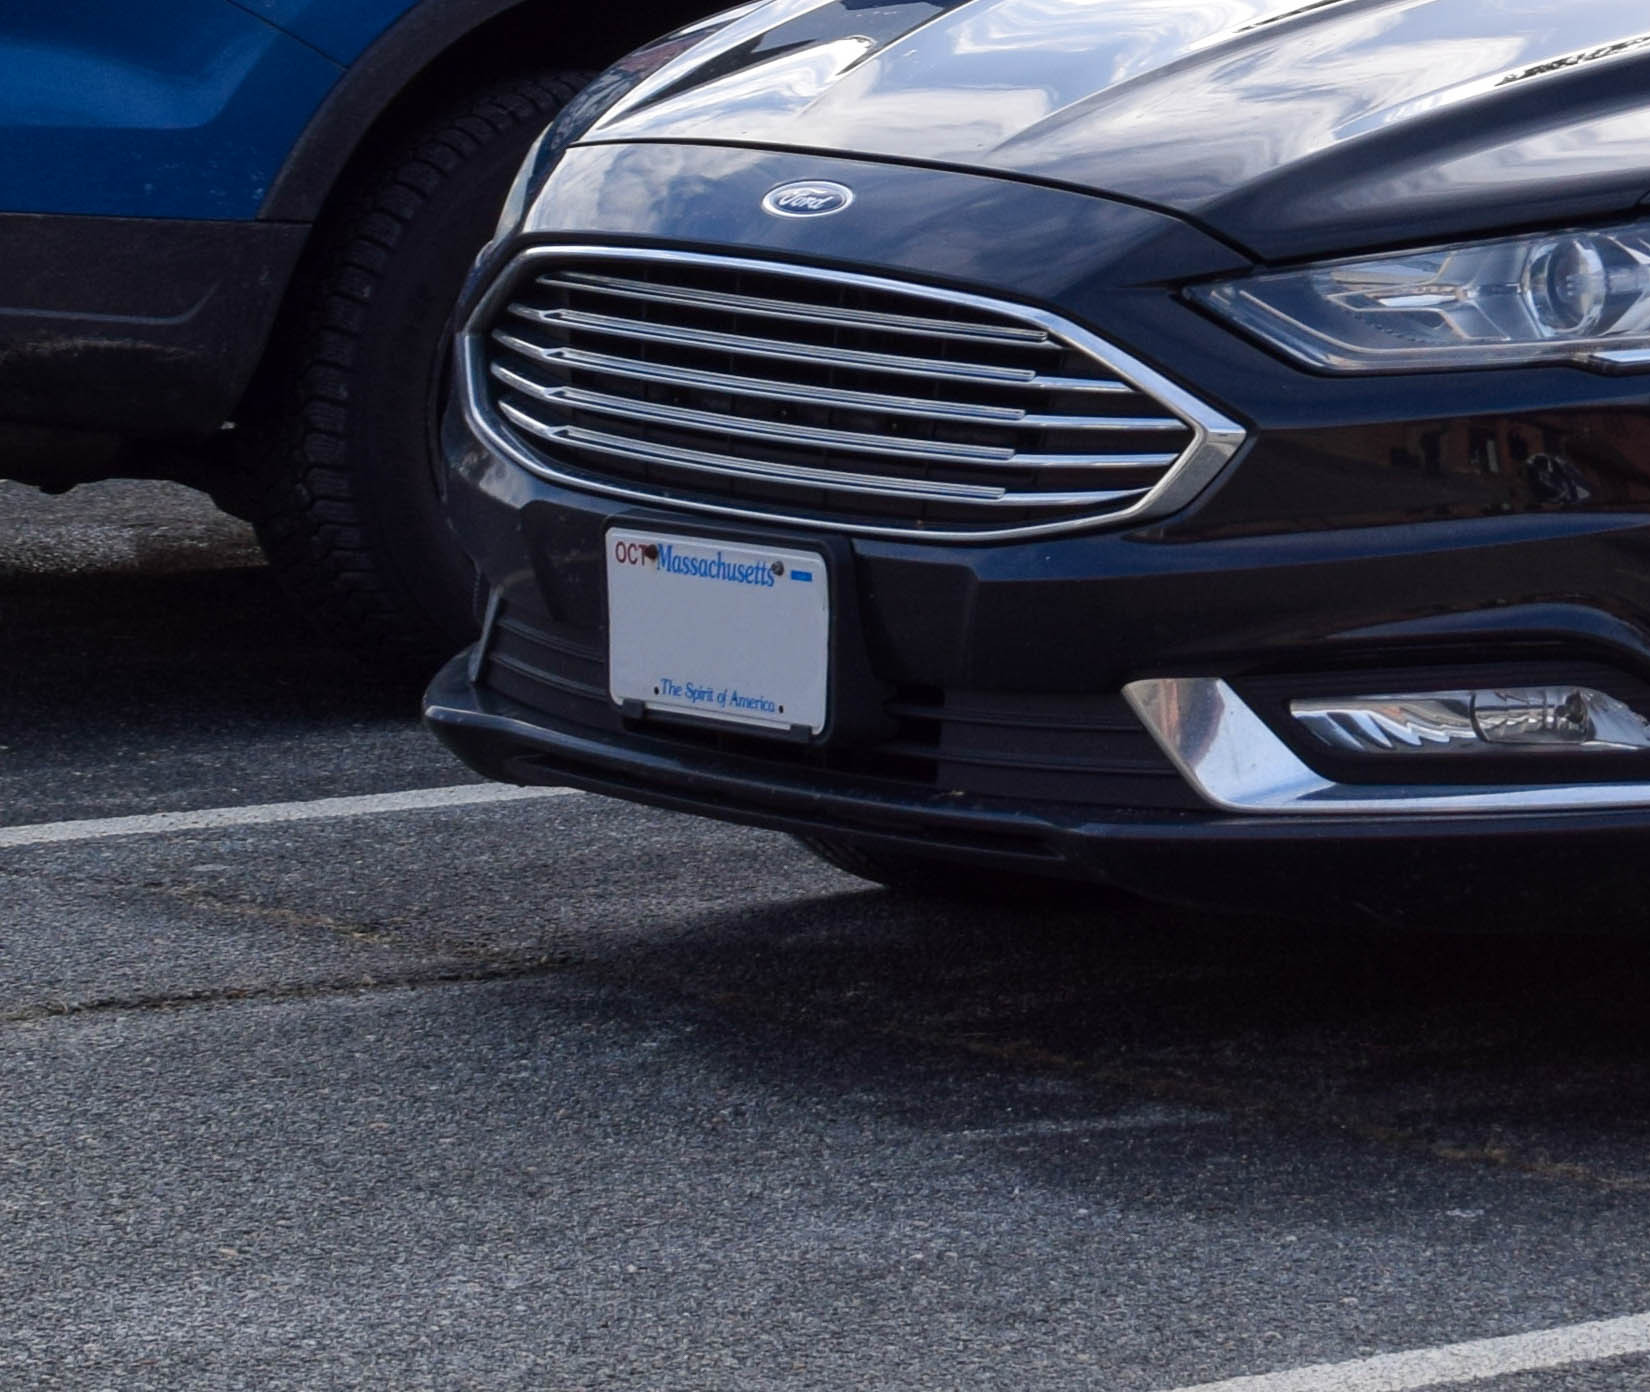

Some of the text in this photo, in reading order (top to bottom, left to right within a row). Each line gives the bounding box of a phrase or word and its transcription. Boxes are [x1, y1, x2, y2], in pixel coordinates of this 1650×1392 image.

[615, 541, 648, 565] OCT
[656, 543, 775, 588] Massachusetts
[661, 678, 775, 713] The Spirit of America
